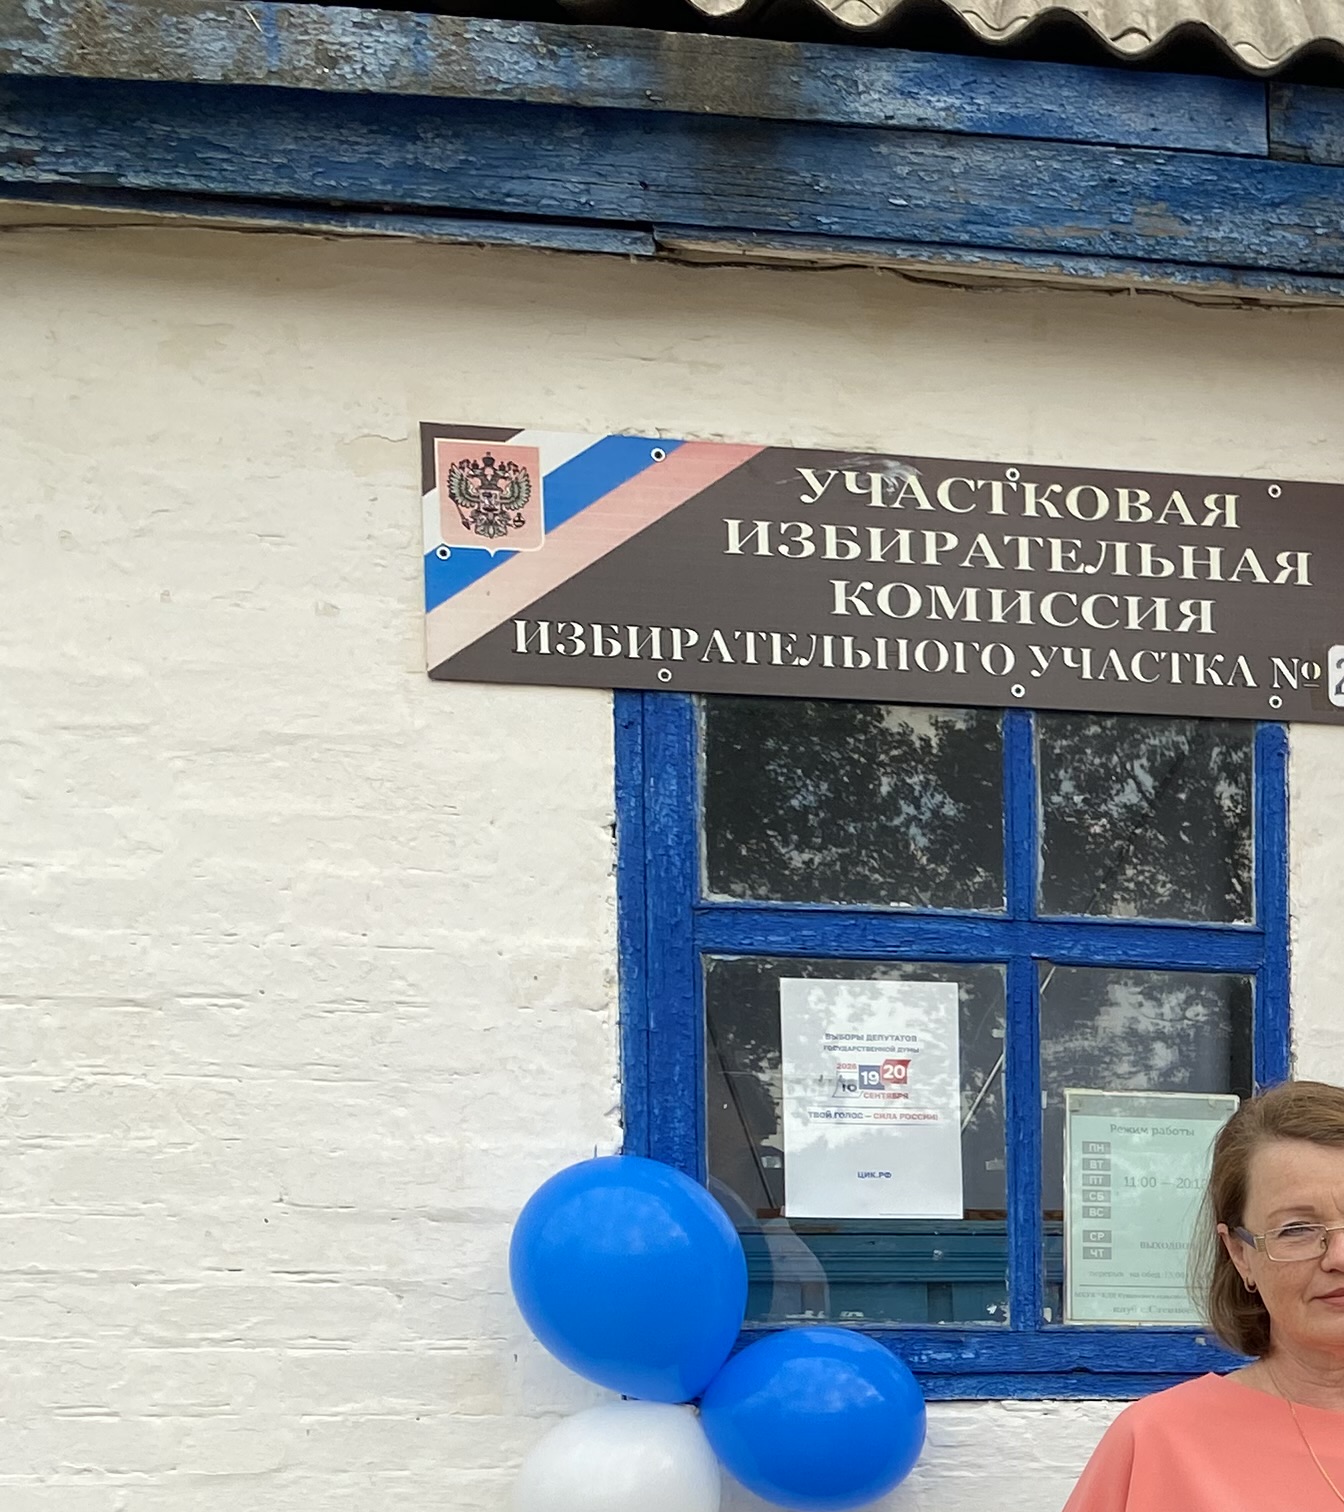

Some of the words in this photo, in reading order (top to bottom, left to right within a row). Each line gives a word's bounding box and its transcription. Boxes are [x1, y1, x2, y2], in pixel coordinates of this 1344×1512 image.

[796, 466, 1240, 529] УЧАСТКОВАЯ
[723, 519, 1313, 587] ИЗБИРАТЕЛЬНАЯ
[830, 579, 1218, 634] КОМИССИЯ
[512, 619, 1015, 677] ИЗБИРАТЕЛЬНОГО
[1029, 644, 1257, 689] УЧАСТКА
[1269, 656, 1322, 690] №
[825, 1033, 864, 1042] ВЫБОРЫ
[866, 1034, 918, 1043] ДЕПУТАТОВ
[823, 1044, 896, 1053] ГОСУДАРСТВЕННОЙ
[897, 1046, 920, 1054] ДУМЫ
[860, 1070, 880, 1085] 19
[883, 1064, 906, 1079] 20
[863, 1091, 909, 1100] СЕНТЯБРЯ
[808, 1110, 833, 1119] ТВОЙ
[834, 1111, 864, 1119] ГОЛОС
[873, 1112, 897, 1120] СИЛА
[1110, 1123, 1149, 1134] Режим
[1151, 1125, 1195, 1137] работы
[1088, 1143, 1105, 1152] ПН
[1089, 1160, 1104, 1169] ВТ
[857, 1171, 892, 1179] ЦИК.РФ
[1089, 1176, 1104, 1185] ПТ
[1089, 1191, 1105, 1201] СБ
[1089, 1207, 1105, 1217] ВС
[1089, 1231, 1105, 1241] СР
[1089, 1248, 1105, 1258] ЧТ
[1139, 1240, 1190, 1250] выходно
